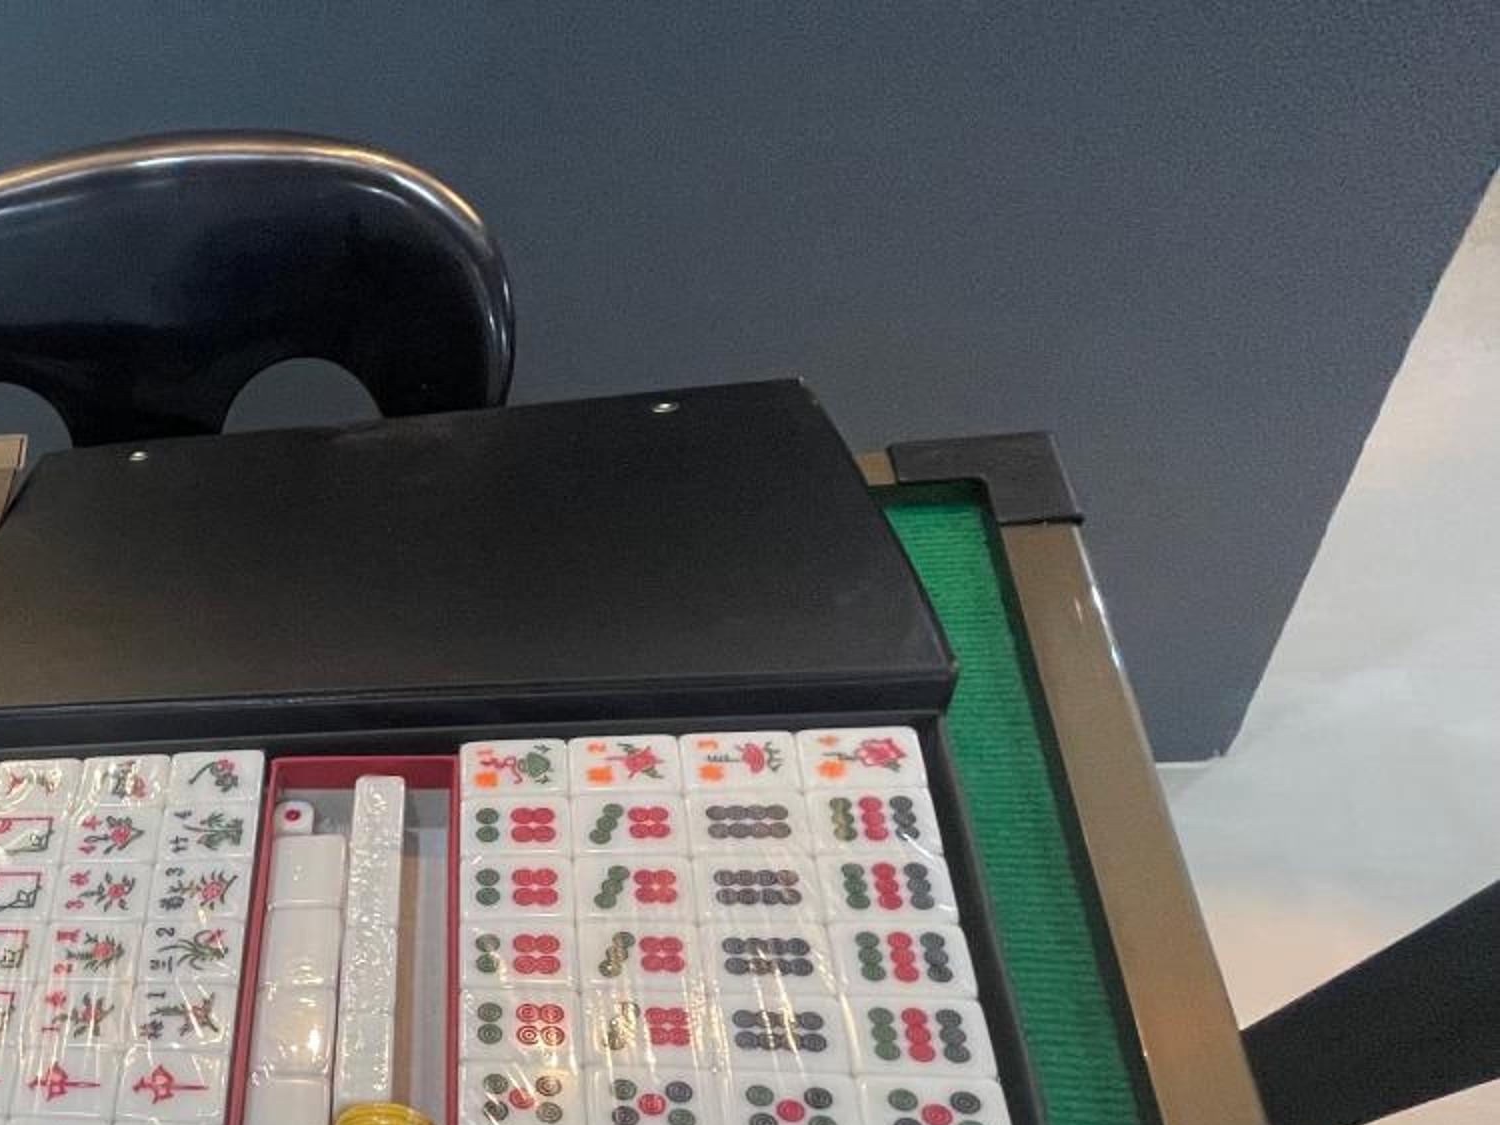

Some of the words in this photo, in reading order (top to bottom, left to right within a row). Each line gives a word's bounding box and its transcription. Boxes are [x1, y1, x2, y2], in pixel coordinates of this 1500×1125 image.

[165, 866, 185, 877] 3
[156, 927, 175, 938] 2
[28, 1061, 100, 1101] 中
[132, 1065, 209, 1104] 中
